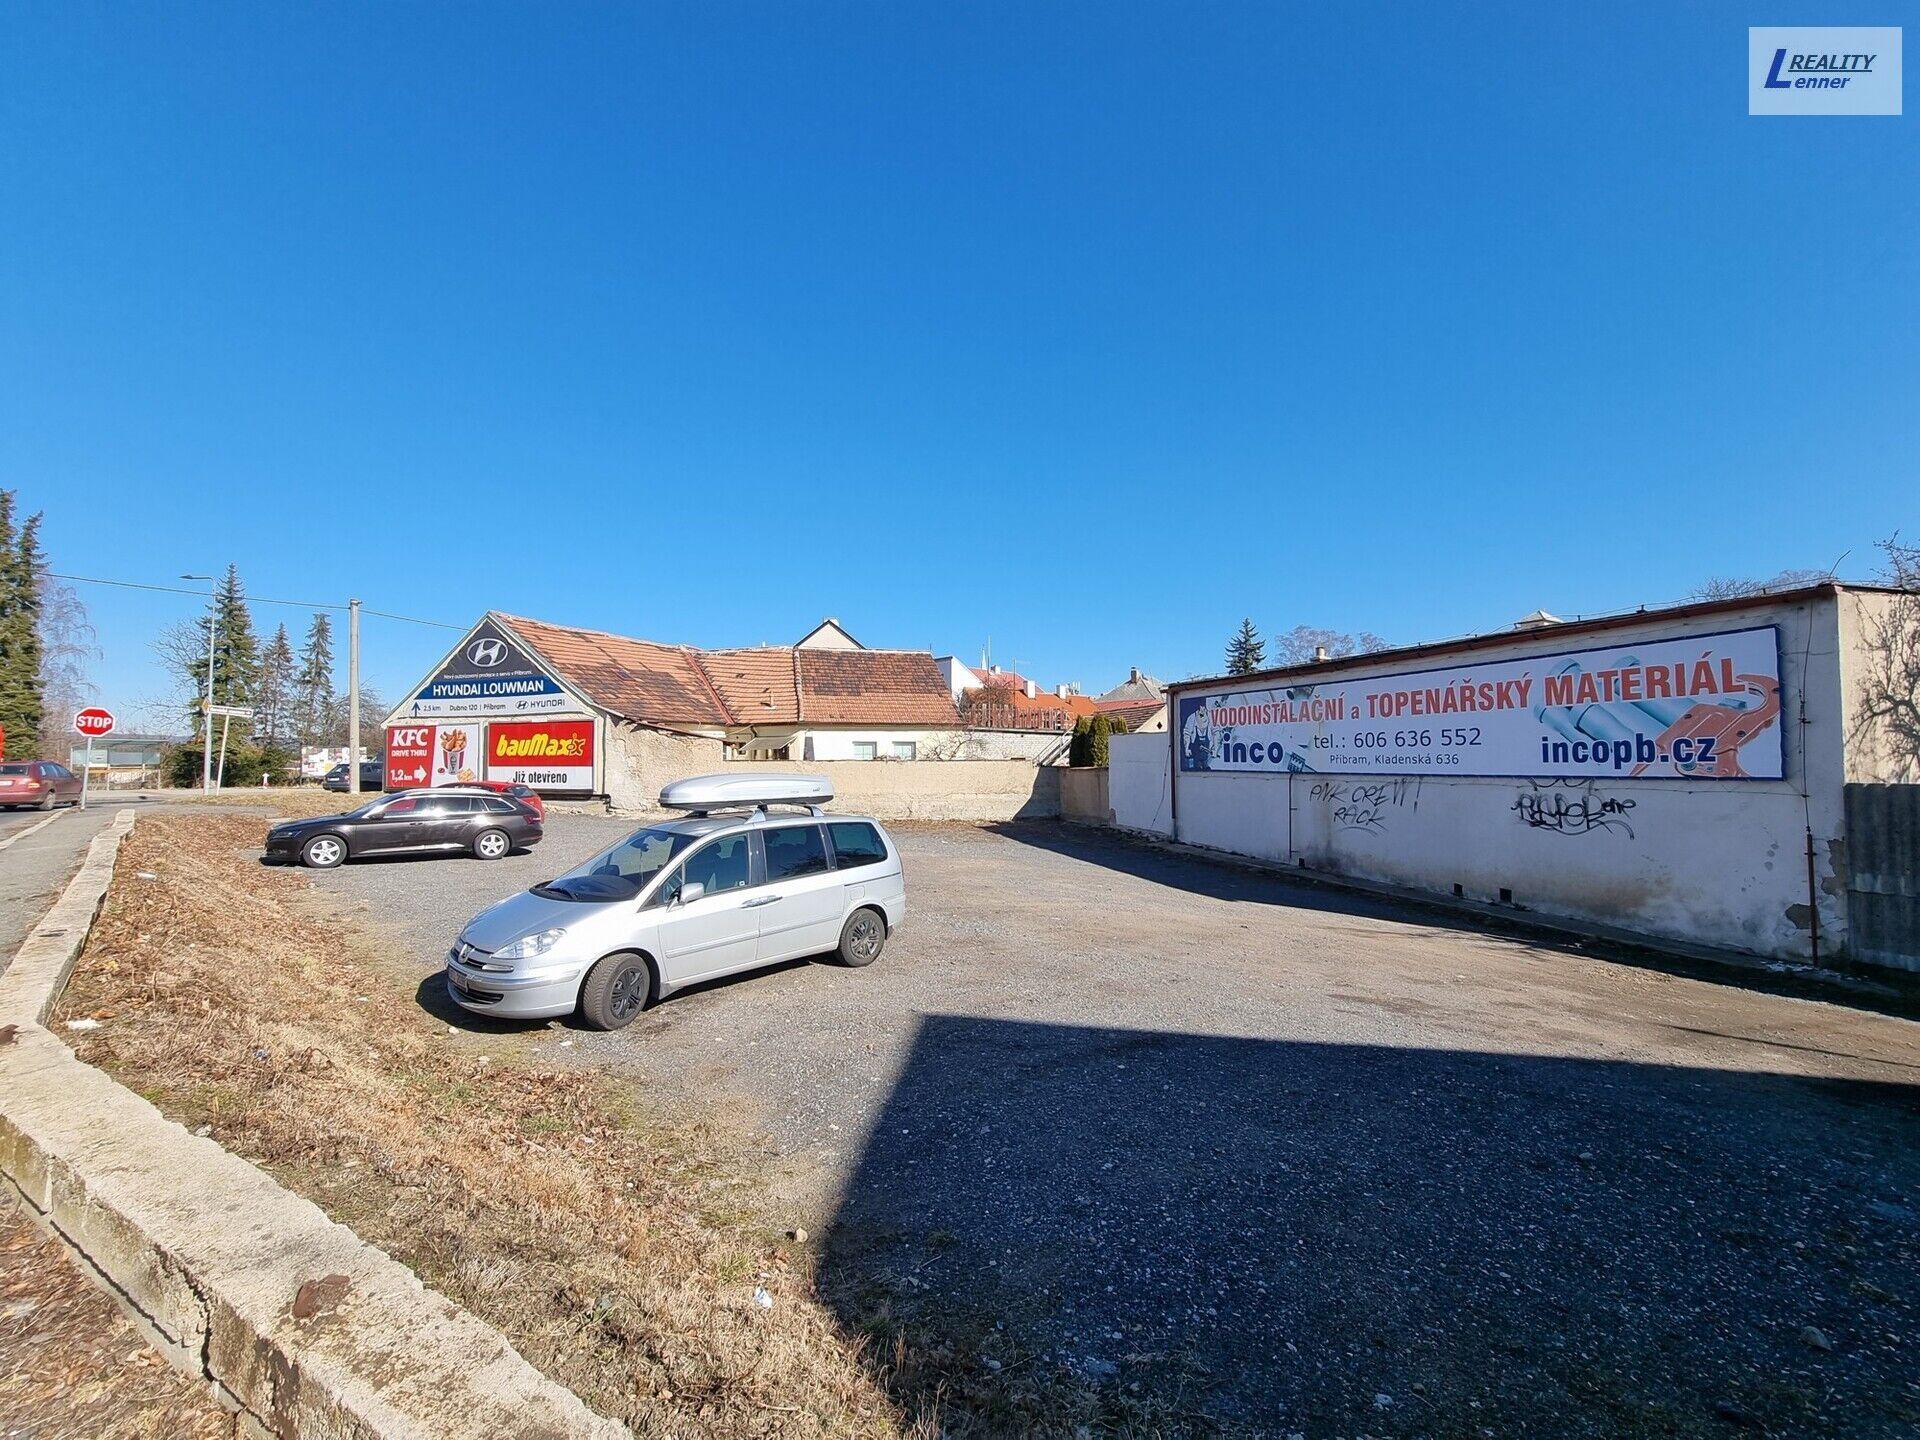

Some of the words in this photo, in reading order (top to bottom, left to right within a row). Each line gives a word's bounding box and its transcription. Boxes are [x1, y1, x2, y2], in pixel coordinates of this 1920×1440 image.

[433, 684, 481, 696] HYUNDAI
[483, 680, 544, 694] LOUWMAN
[1351, 706, 1360, 719] a
[1366, 672, 1532, 718] TOPENÁŘSKÝ
[1544, 651, 1746, 706] MATERIÁL
[432, 704, 441, 712] km
[449, 704, 468, 712] Dubno
[483, 702, 506, 711] Příbram
[530, 699, 565, 708] HYUNDAI
[77, 716, 111, 728] STOP
[391, 729, 428, 747] KFC
[1313, 733, 1346, 748] tel.:
[1353, 732, 1387, 748] 606
[1394, 730, 1432, 747] 636
[1440, 728, 1482, 746] 552
[410, 749, 427, 757] THRU
[1223, 733, 1284, 764] inco
[1541, 733, 1717, 769] incopb.cz
[1329, 754, 1371, 765] Příbram,
[1375, 753, 1432, 765] Kladenská
[1436, 754, 1459, 765] 636
[390, 769, 404, 782] 1,2
[513, 771, 525, 783] Již
[528, 771, 567, 783] otevřeno
